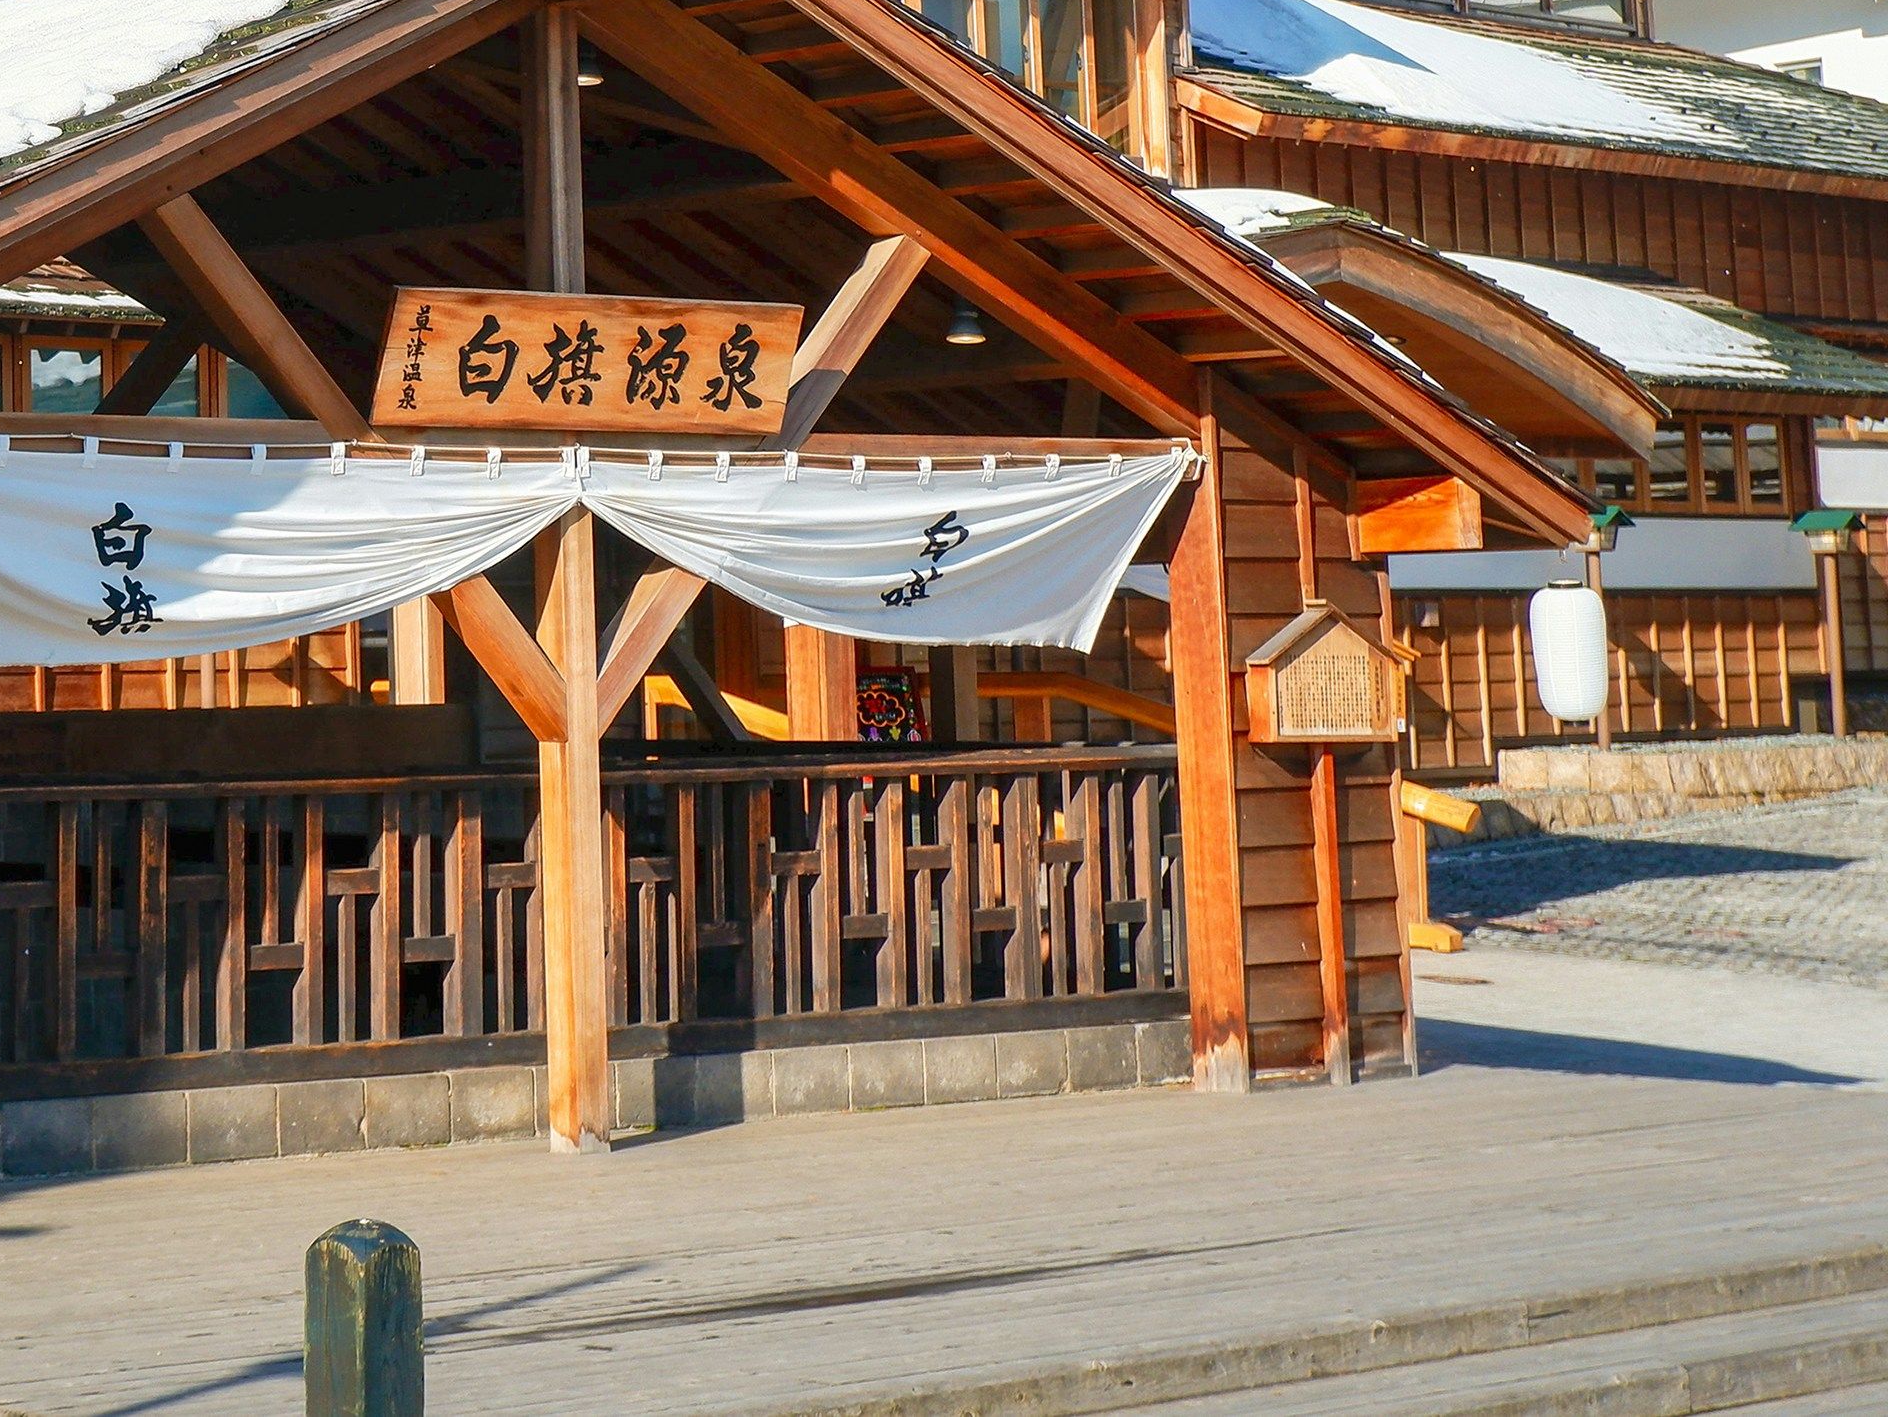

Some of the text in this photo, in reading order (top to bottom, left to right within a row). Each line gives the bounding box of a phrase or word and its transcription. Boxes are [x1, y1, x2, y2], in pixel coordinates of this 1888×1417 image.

[396, 304, 434, 411] 草津温泉
[457, 313, 765, 413] 白旗源泉
[86, 501, 165, 637] 白旗
